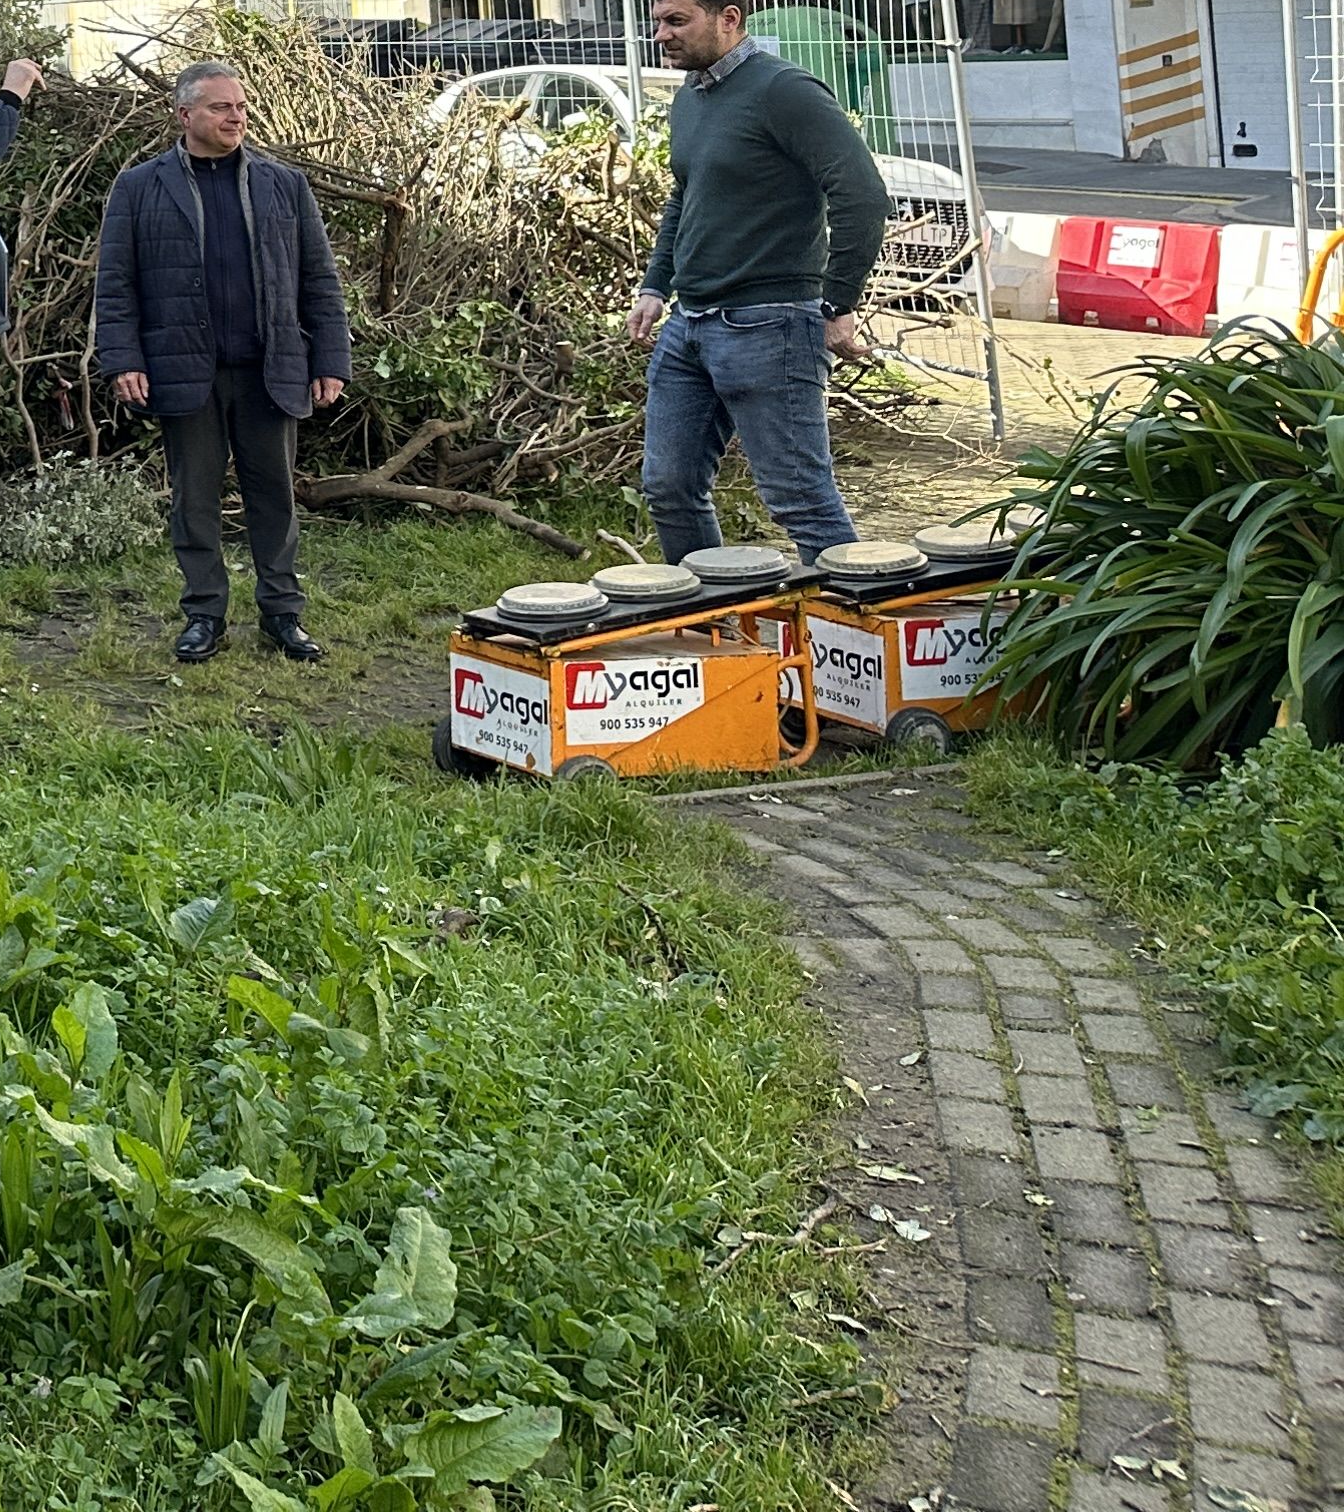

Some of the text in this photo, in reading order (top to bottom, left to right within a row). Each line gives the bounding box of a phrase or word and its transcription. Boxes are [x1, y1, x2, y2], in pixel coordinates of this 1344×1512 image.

[810, 640, 882, 680] yagal
[573, 663, 699, 704] Myagal
[940, 675, 961, 687] 900
[460, 677, 548, 726] Myagal
[625, 698, 683, 708] ALQUILER
[826, 689, 842, 703] 535
[844, 694, 860, 709] 947
[600, 716, 669, 730] 900 535 947
[479, 729, 529, 754] 900 535 947
